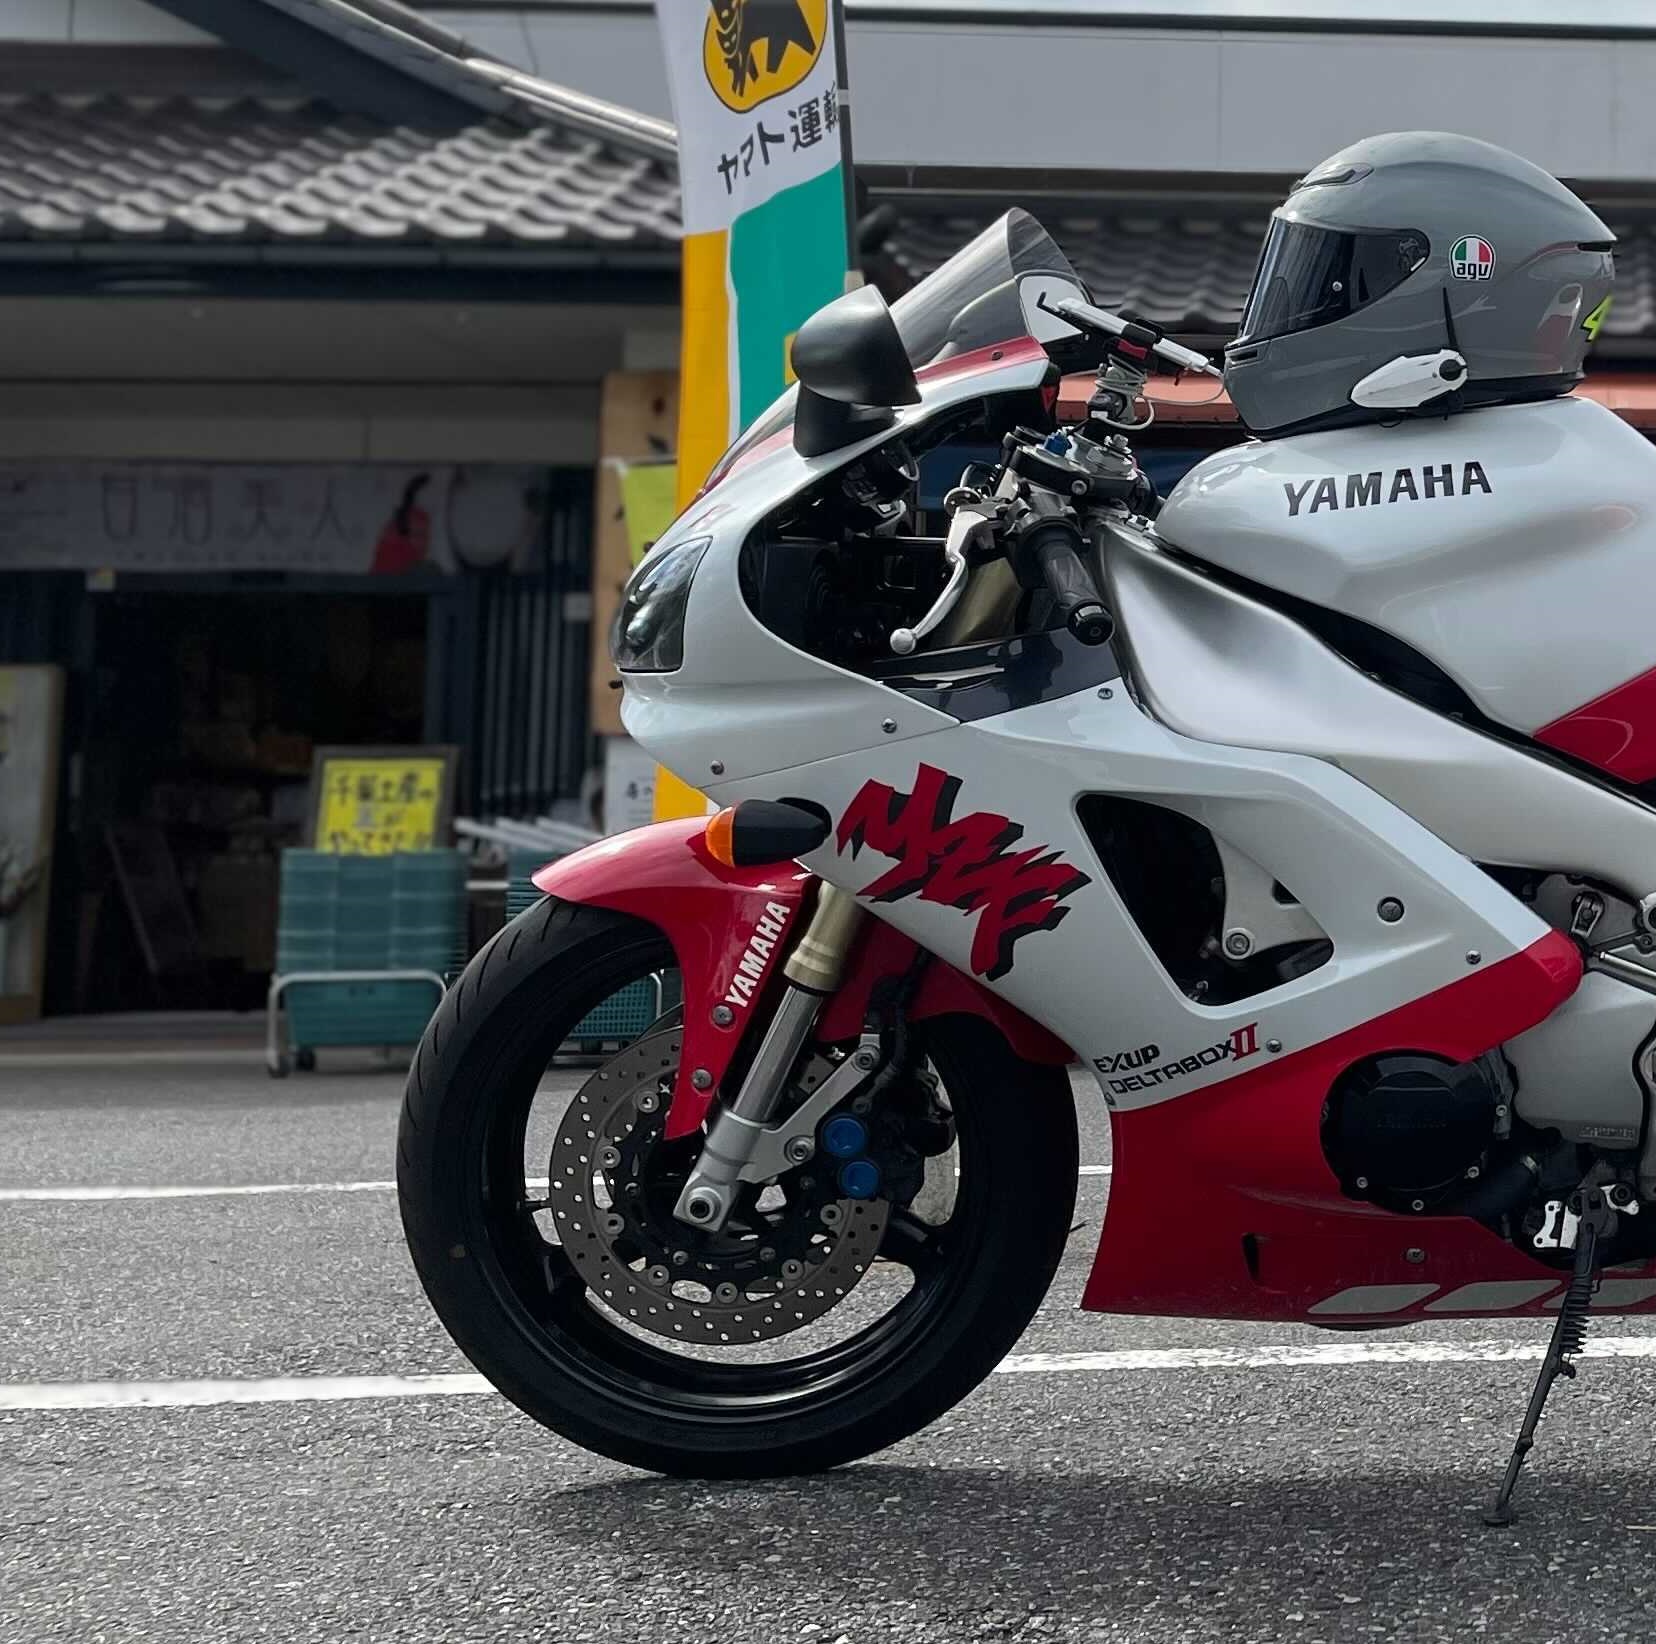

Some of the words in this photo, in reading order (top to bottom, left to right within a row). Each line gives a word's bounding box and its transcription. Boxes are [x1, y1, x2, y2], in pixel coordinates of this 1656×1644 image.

[1456, 262, 1489, 280] agv
[1284, 461, 1493, 517] YAMAHA
[724, 901, 791, 1008] YAMAHA
[1093, 1044, 1161, 1073] EXUP
